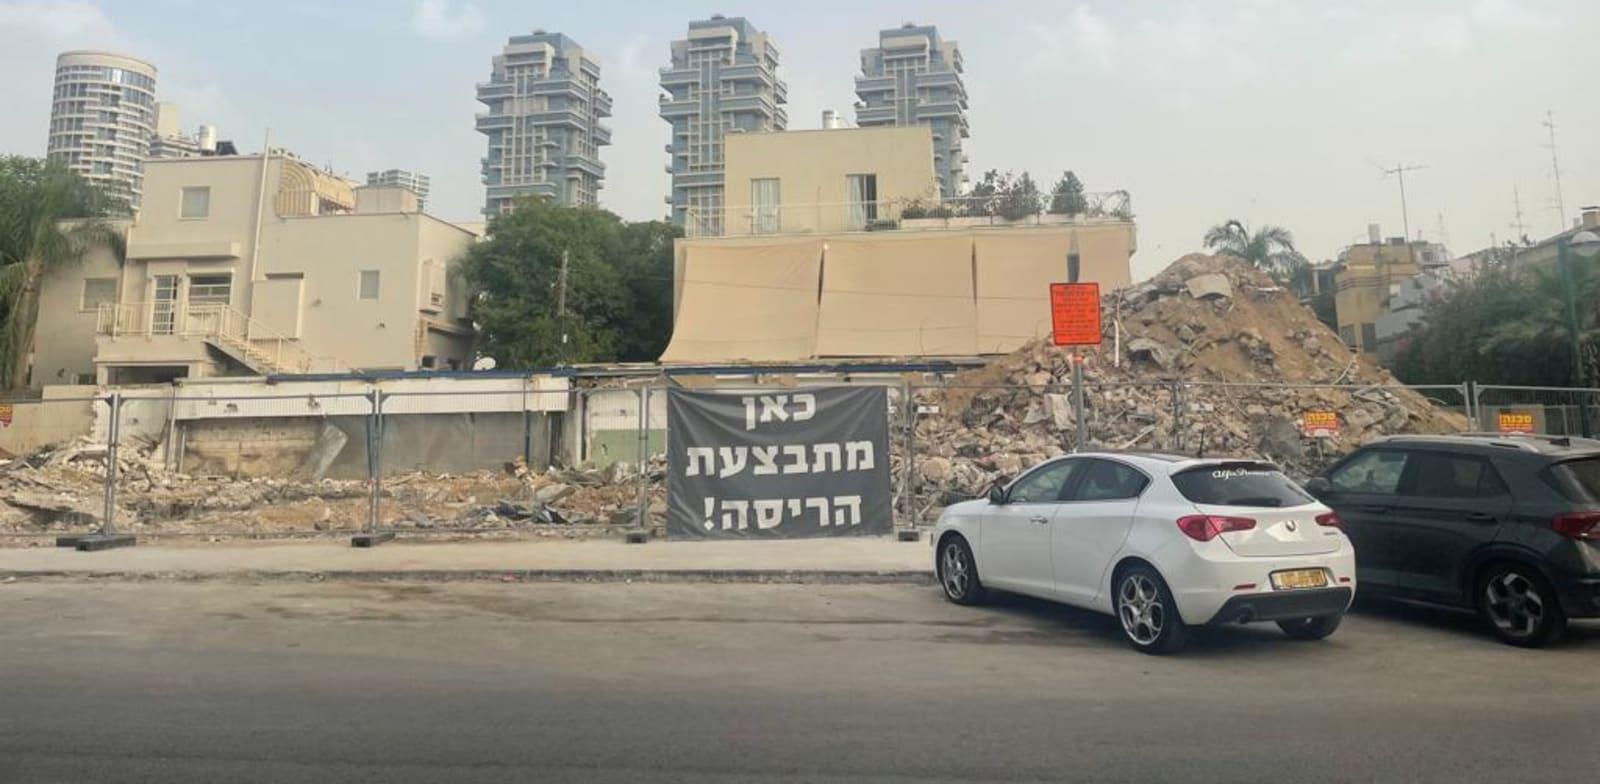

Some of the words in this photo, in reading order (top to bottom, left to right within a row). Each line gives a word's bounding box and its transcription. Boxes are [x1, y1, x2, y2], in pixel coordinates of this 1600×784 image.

[742, 393, 816, 431] כאן
[685, 440, 874, 479] מתבצעת
[703, 495, 862, 531] הריסה!
